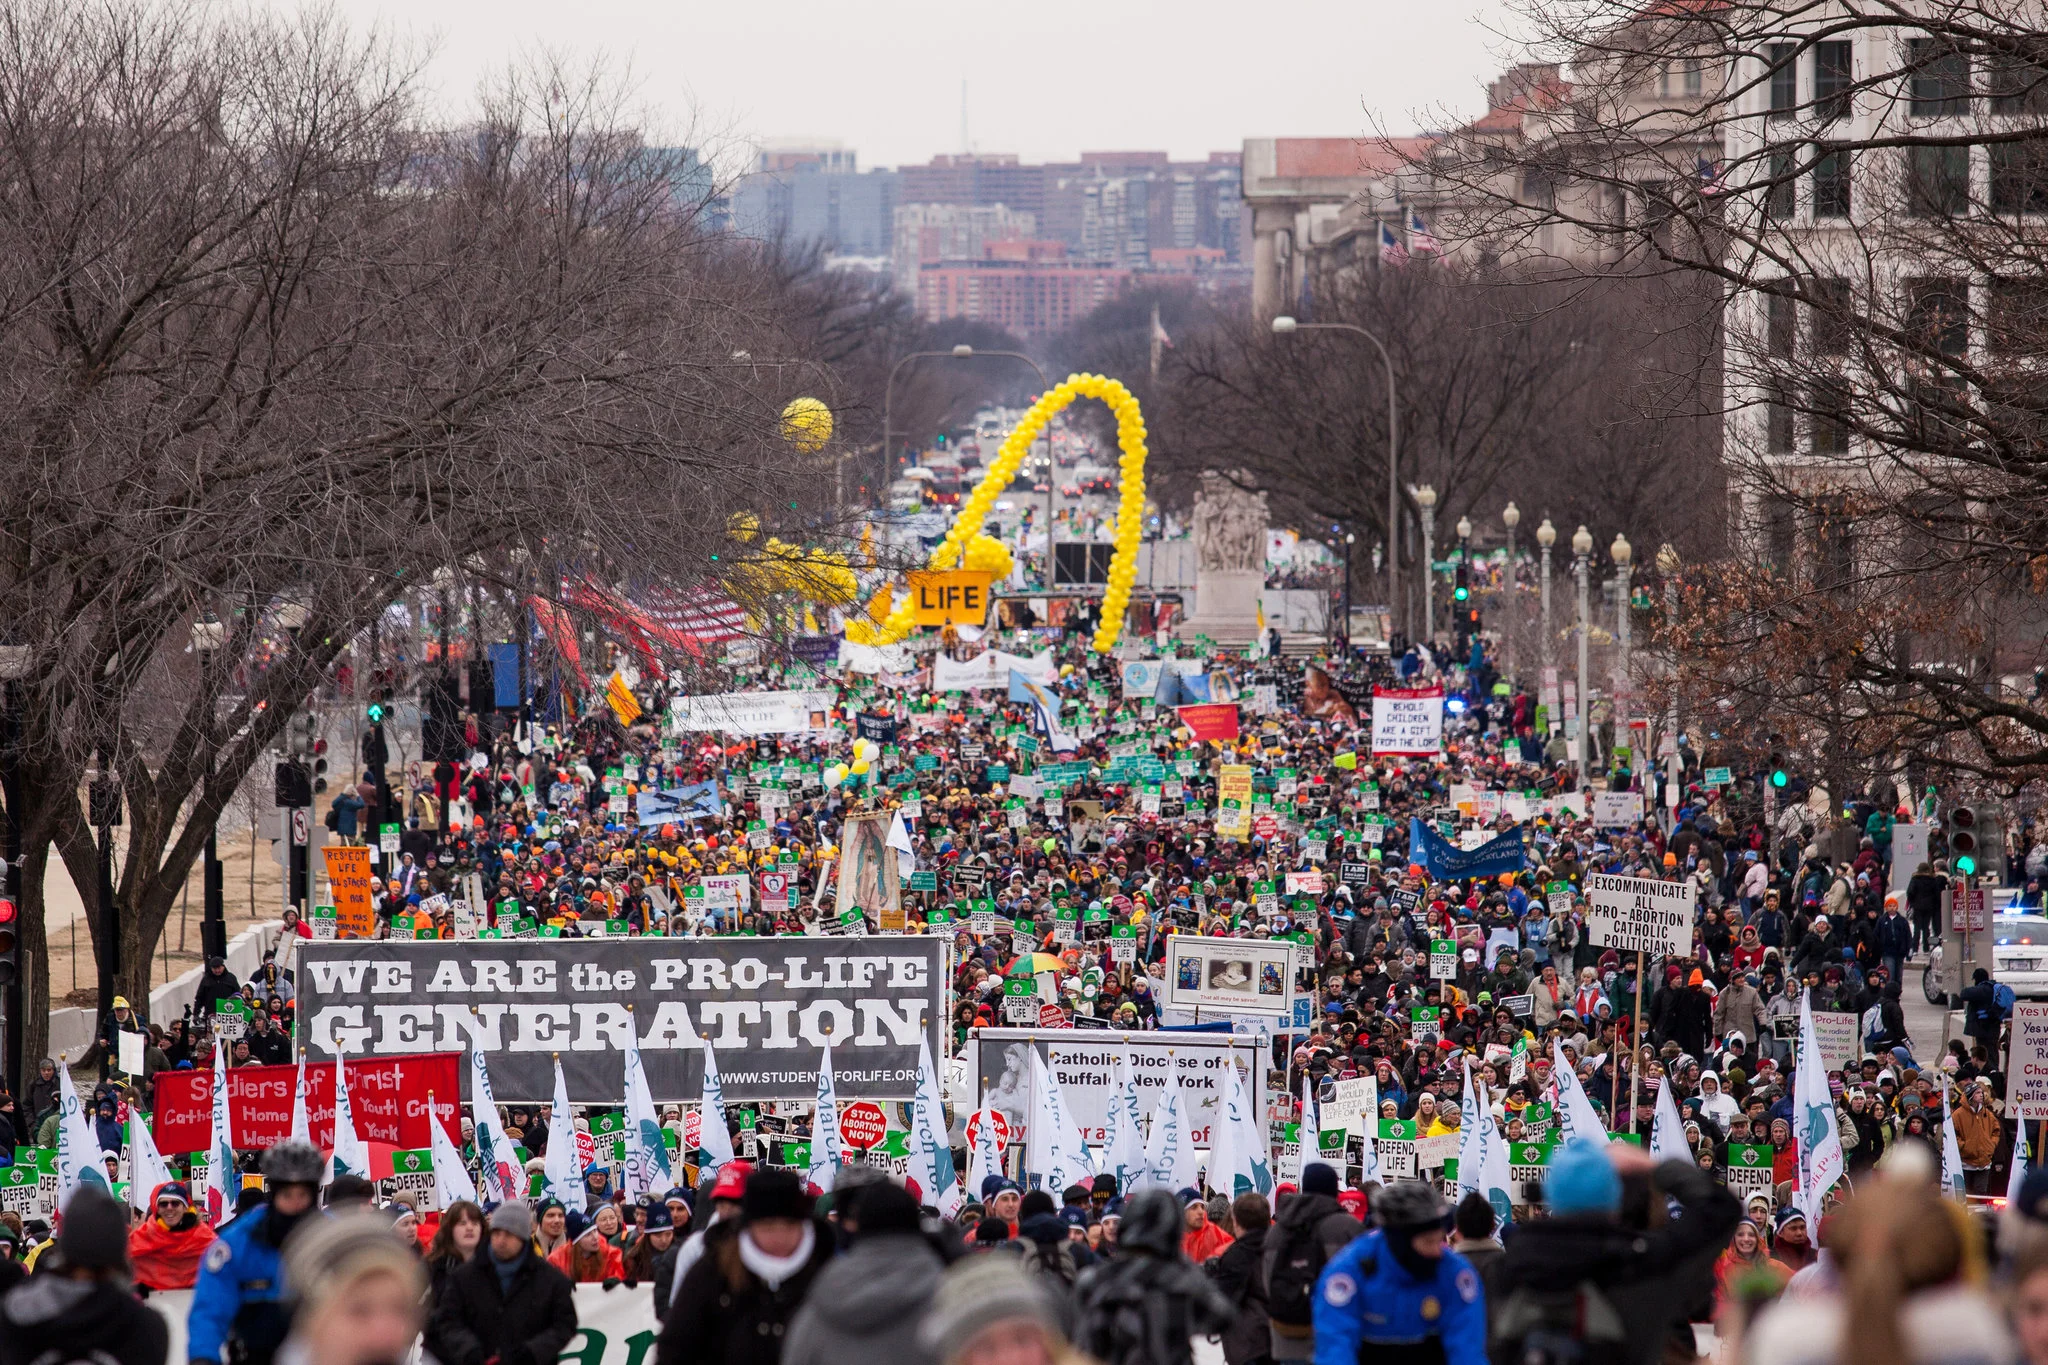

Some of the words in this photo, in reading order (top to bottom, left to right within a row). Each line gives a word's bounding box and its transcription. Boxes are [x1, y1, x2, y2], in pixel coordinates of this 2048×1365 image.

[920, 586, 979, 610] LIFE
[752, 713, 775, 721] LIFE
[1387, 714, 1429, 722] CHILDREN
[1382, 726, 1396, 734] ARE
[1410, 726, 1431, 735] GIFT
[1376, 738, 1396, 746] FROM
[1400, 738, 1414, 747] THE
[1369, 833, 1379, 841] LIFE
[385, 842, 396, 850] LIFE
[1554, 902, 1566, 910] LIFE
[1635, 896, 1654, 910] ALL
[690, 908, 700, 916] LIFE
[1262, 904, 1275, 913] LIFE
[498, 914, 520, 924] DEFEND
[972, 912, 994, 922] DEFEND
[1296, 912, 1316, 920] DEFEND
[504, 924, 512, 934] LIF
[930, 924, 950, 934] DEFEND
[976, 922, 988, 932] LIFE
[1056, 920, 1076, 930] DEFEND
[1302, 920, 1313, 928] IFE
[391, 929, 412, 938] DEFEND
[1014, 933, 1033, 944] DEFEND
[1059, 930, 1071, 940] LIFE
[1017, 942, 1028, 952] LIFE
[1113, 938, 1136, 948] DEFEND
[1117, 948, 1130, 958] LIFE
[1432, 954, 1456, 964] DEFEND
[306, 961, 412, 994] WE
[426, 960, 557, 992] ARE
[568, 962, 636, 992] the
[650, 956, 928, 990] PRO-LIFE
[1436, 966, 1450, 975] LIFE
[1007, 997, 1030, 1007] DEFEND
[1013, 1008, 1026, 1018] LIFE
[1041, 1008, 1058, 1016] STOP
[2019, 1007, 2039, 1016] Yes
[217, 1014, 243, 1024] DEFEND
[223, 1025, 237, 1035] LIFE
[310, 999, 928, 1053] GENERATION
[1413, 1023, 1440, 1033] DEFEND
[2023, 1022, 2040, 1034] Yes
[1052, 1050, 1121, 1066] Catholic
[1204, 1056, 1222, 1070] of
[720, 1069, 921, 1084] WWW.STUDENTFORLIFE.ORG
[1513, 1065, 1524, 1080] LIFE
[190, 1076, 288, 1100] Sodiers
[302, 1069, 326, 1094] of
[344, 1063, 404, 1092] Christ
[1133, 1073, 1168, 1088] New
[1177, 1075, 1214, 1088] York
[1342, 1080, 1360, 1090] WHY
[2025, 1080, 2042, 1088] we
[1340, 1088, 1364, 1099] WOULD
[1367, 1088, 1372, 1096] A
[784, 1101, 800, 1111] LIFE
[916, 1066, 936, 1154] March
[1324, 1100, 1362, 1112] BACTERIA
[1366, 1098, 1375, 1106] BE
[243, 1106, 288, 1122] Home
[305, 1104, 336, 1123] Scho
[406, 1100, 454, 1121] Grup
[850, 1109, 881, 1122] STOP
[1344, 1108, 1355, 1116] ON
[817, 1075, 838, 1164] March
[843, 1118, 884, 1132] ABORTION
[364, 1122, 398, 1142] York
[848, 1130, 875, 1142] NOW
[1192, 1126, 1210, 1142] of
[594, 1131, 624, 1148] DEFEND
[1286, 1144, 1300, 1156] DEF
[1380, 1141, 1414, 1156] DEFEND
[603, 1150, 614, 1161] LIF
[1387, 1157, 1406, 1170] LIFE
[1729, 1168, 1772, 1184] DEFEND
[40, 1176, 58, 1191] DEF
[397, 1173, 436, 1190] DEFEND
[4, 1186, 36, 1202] DEFEND
[416, 1192, 430, 1206] IFE
[12, 1202, 31, 1216] LIFE
